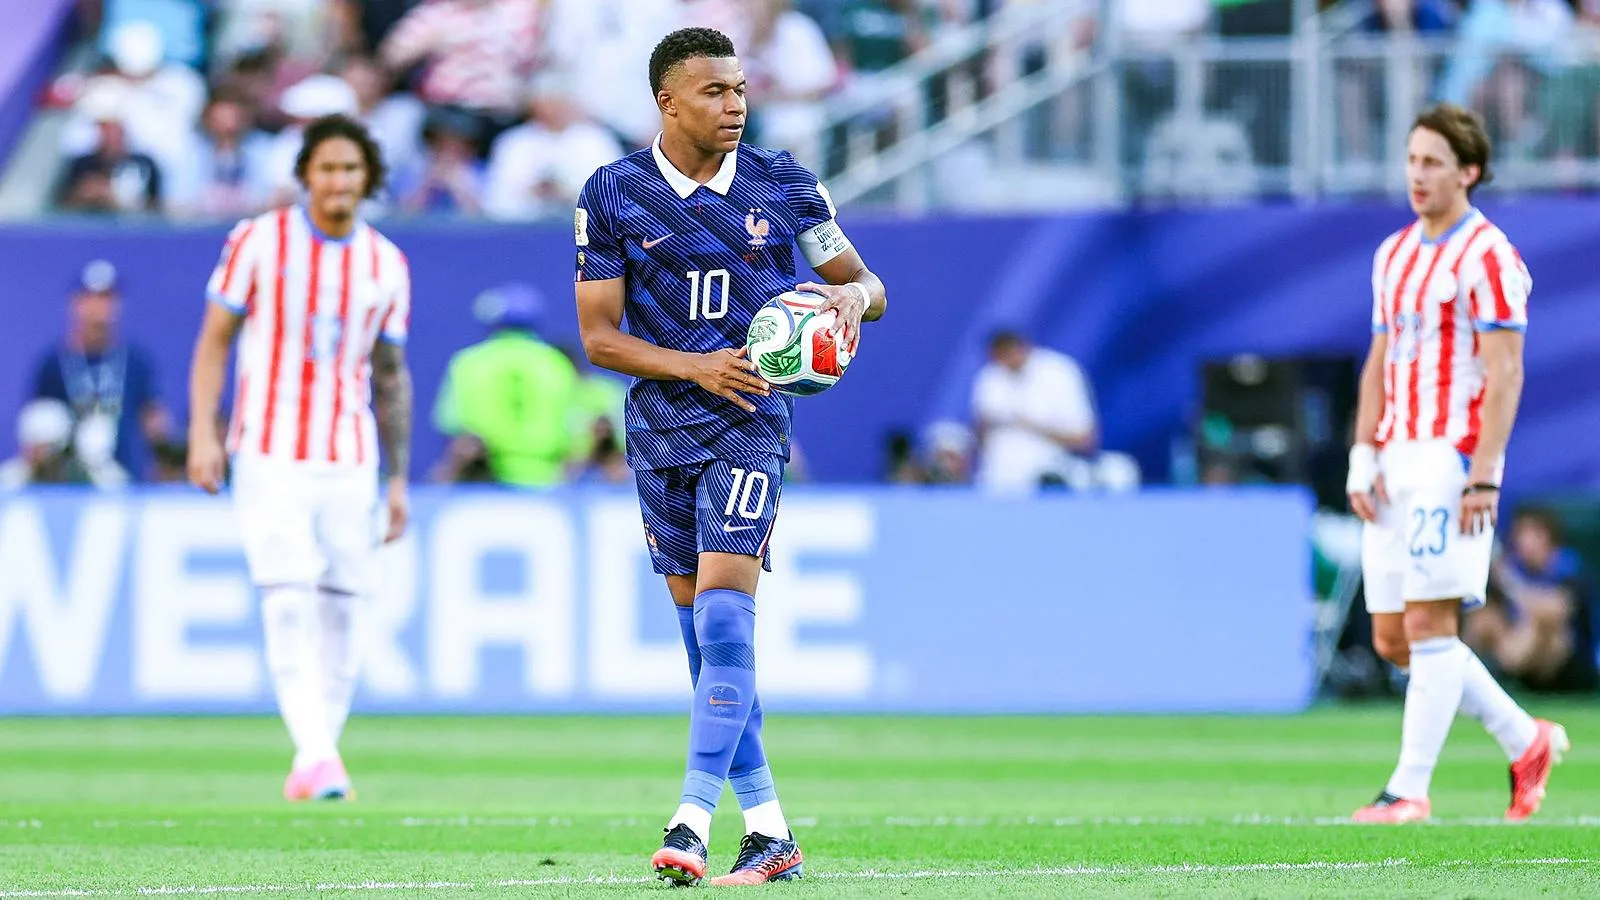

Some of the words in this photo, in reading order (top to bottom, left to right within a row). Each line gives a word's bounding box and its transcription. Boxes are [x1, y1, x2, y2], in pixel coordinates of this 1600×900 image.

[686, 268, 730, 320] 10
[724, 467, 769, 520] 10
[1409, 507, 1449, 557] 23
